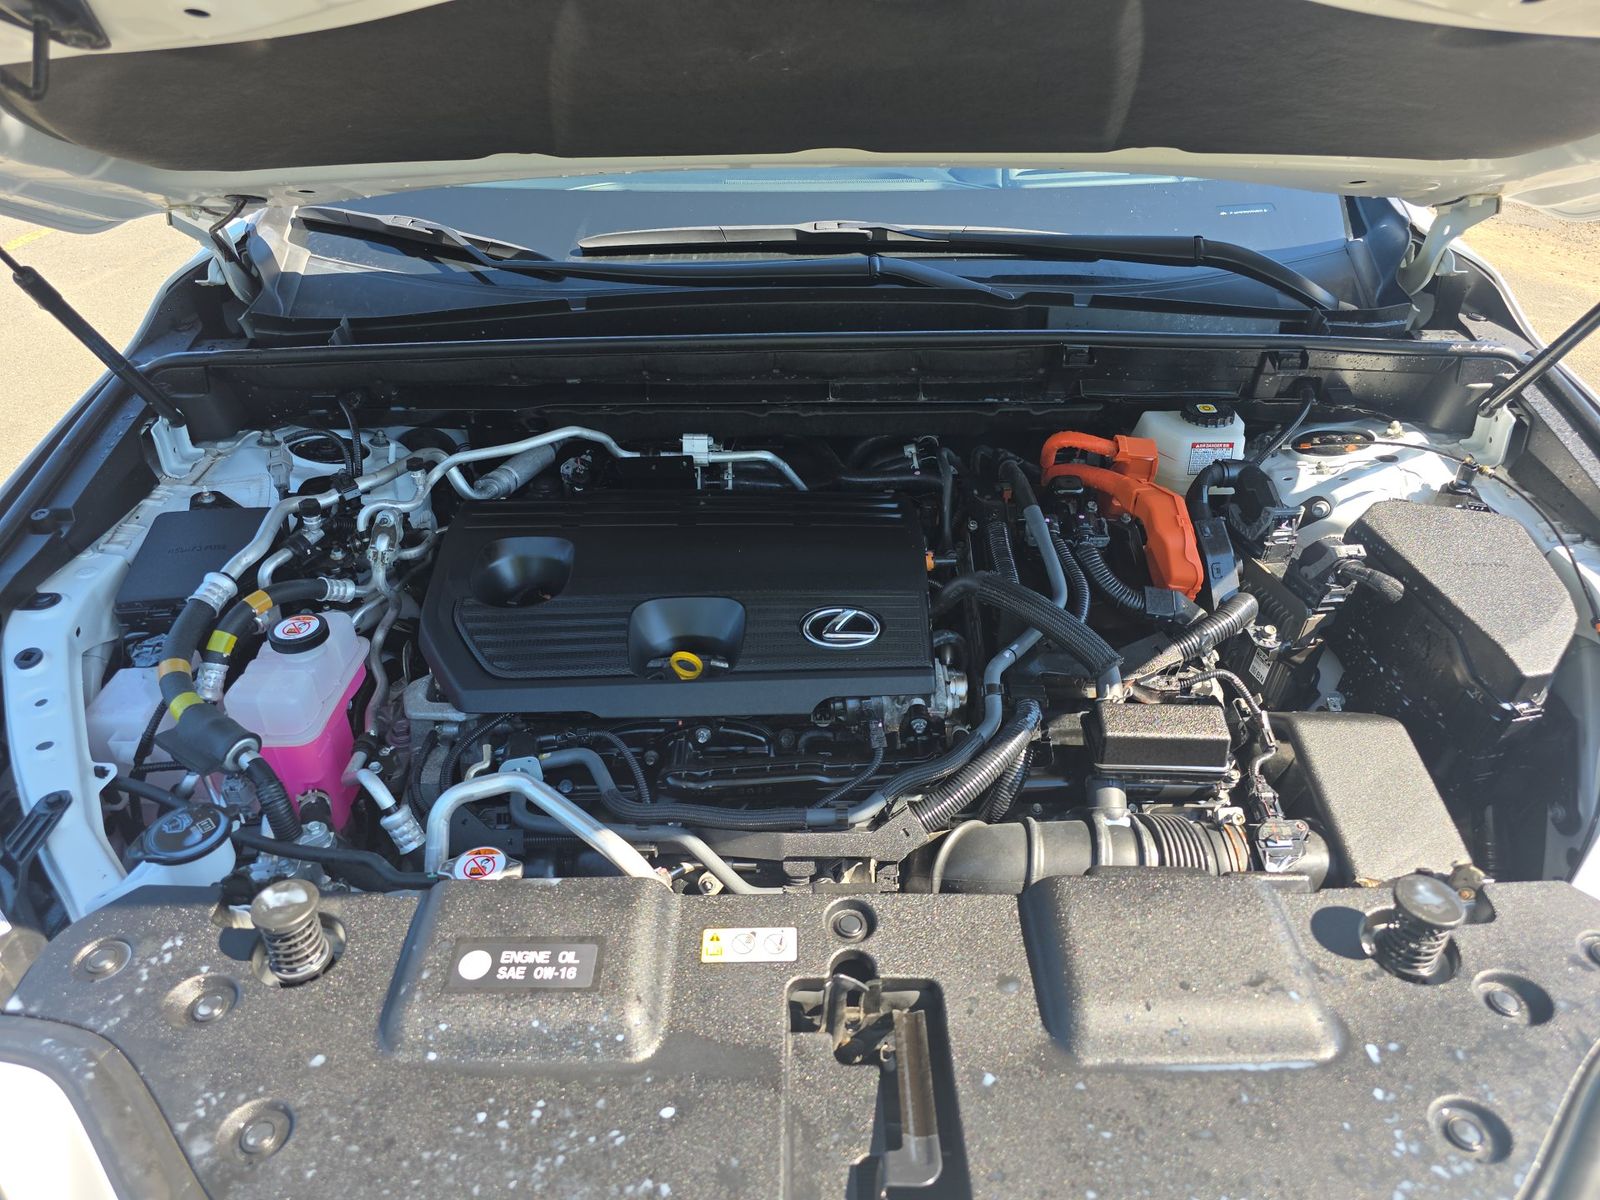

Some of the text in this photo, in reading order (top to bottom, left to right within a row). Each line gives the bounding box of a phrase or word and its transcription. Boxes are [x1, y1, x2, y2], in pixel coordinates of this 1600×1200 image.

[500, 951, 580, 964] ENGINE OIL
[496, 966, 578, 980] SAE 0W-16
